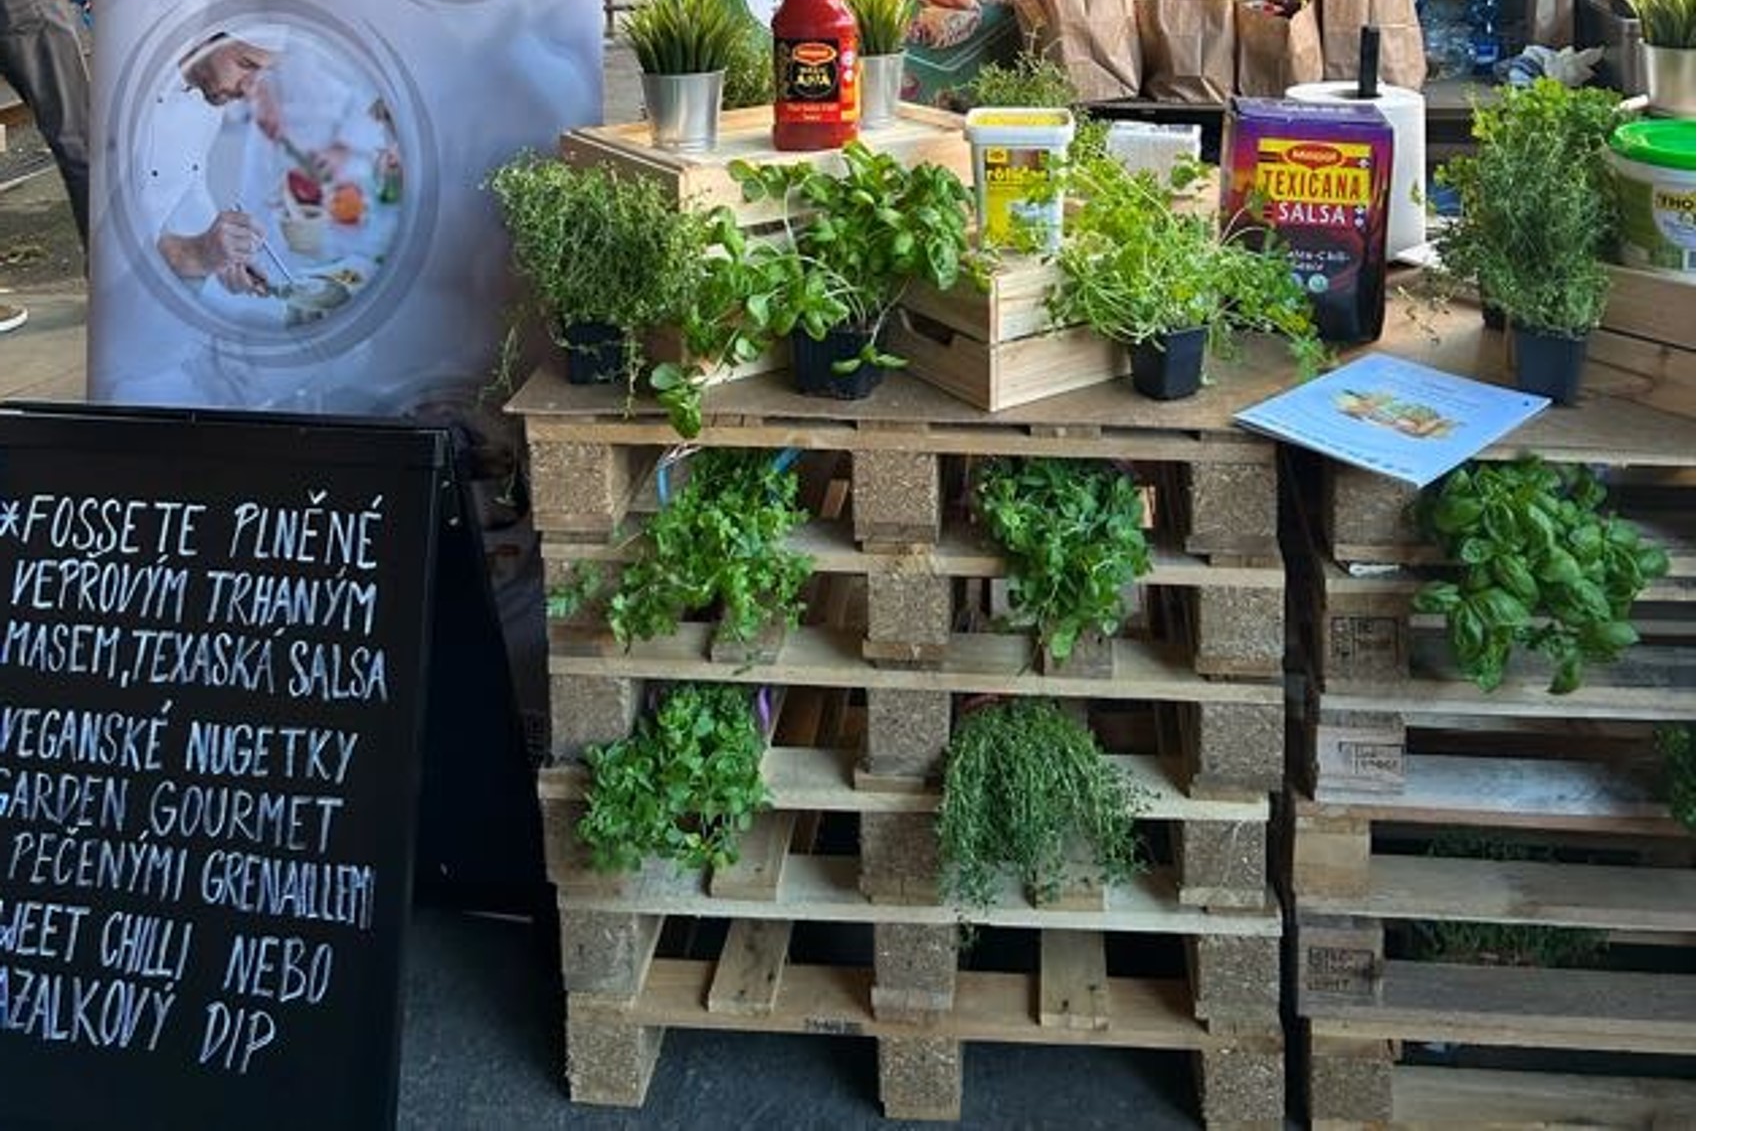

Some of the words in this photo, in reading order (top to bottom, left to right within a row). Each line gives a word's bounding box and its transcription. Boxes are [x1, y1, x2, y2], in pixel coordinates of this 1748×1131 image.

[1263, 170, 1361, 201] TEXICANA
[1278, 201, 1346, 225] SALSA
[230, 489, 384, 569] PLNĚNÉ
[11, 553, 189, 623] VEPŘOVÝM
[207, 566, 377, 635] TRHANÝM
[288, 639, 389, 701] SALSA
[0, 700, 172, 772] VEGANSKÉ
[185, 720, 359, 784] NUGETKY
[150, 780, 345, 854] GOURMET
[8, 826, 189, 902] PEČENÝMI
[100, 911, 193, 981] CHILLI
[222, 933, 333, 1004] NEBO
[199, 1000, 276, 1074] DIP
